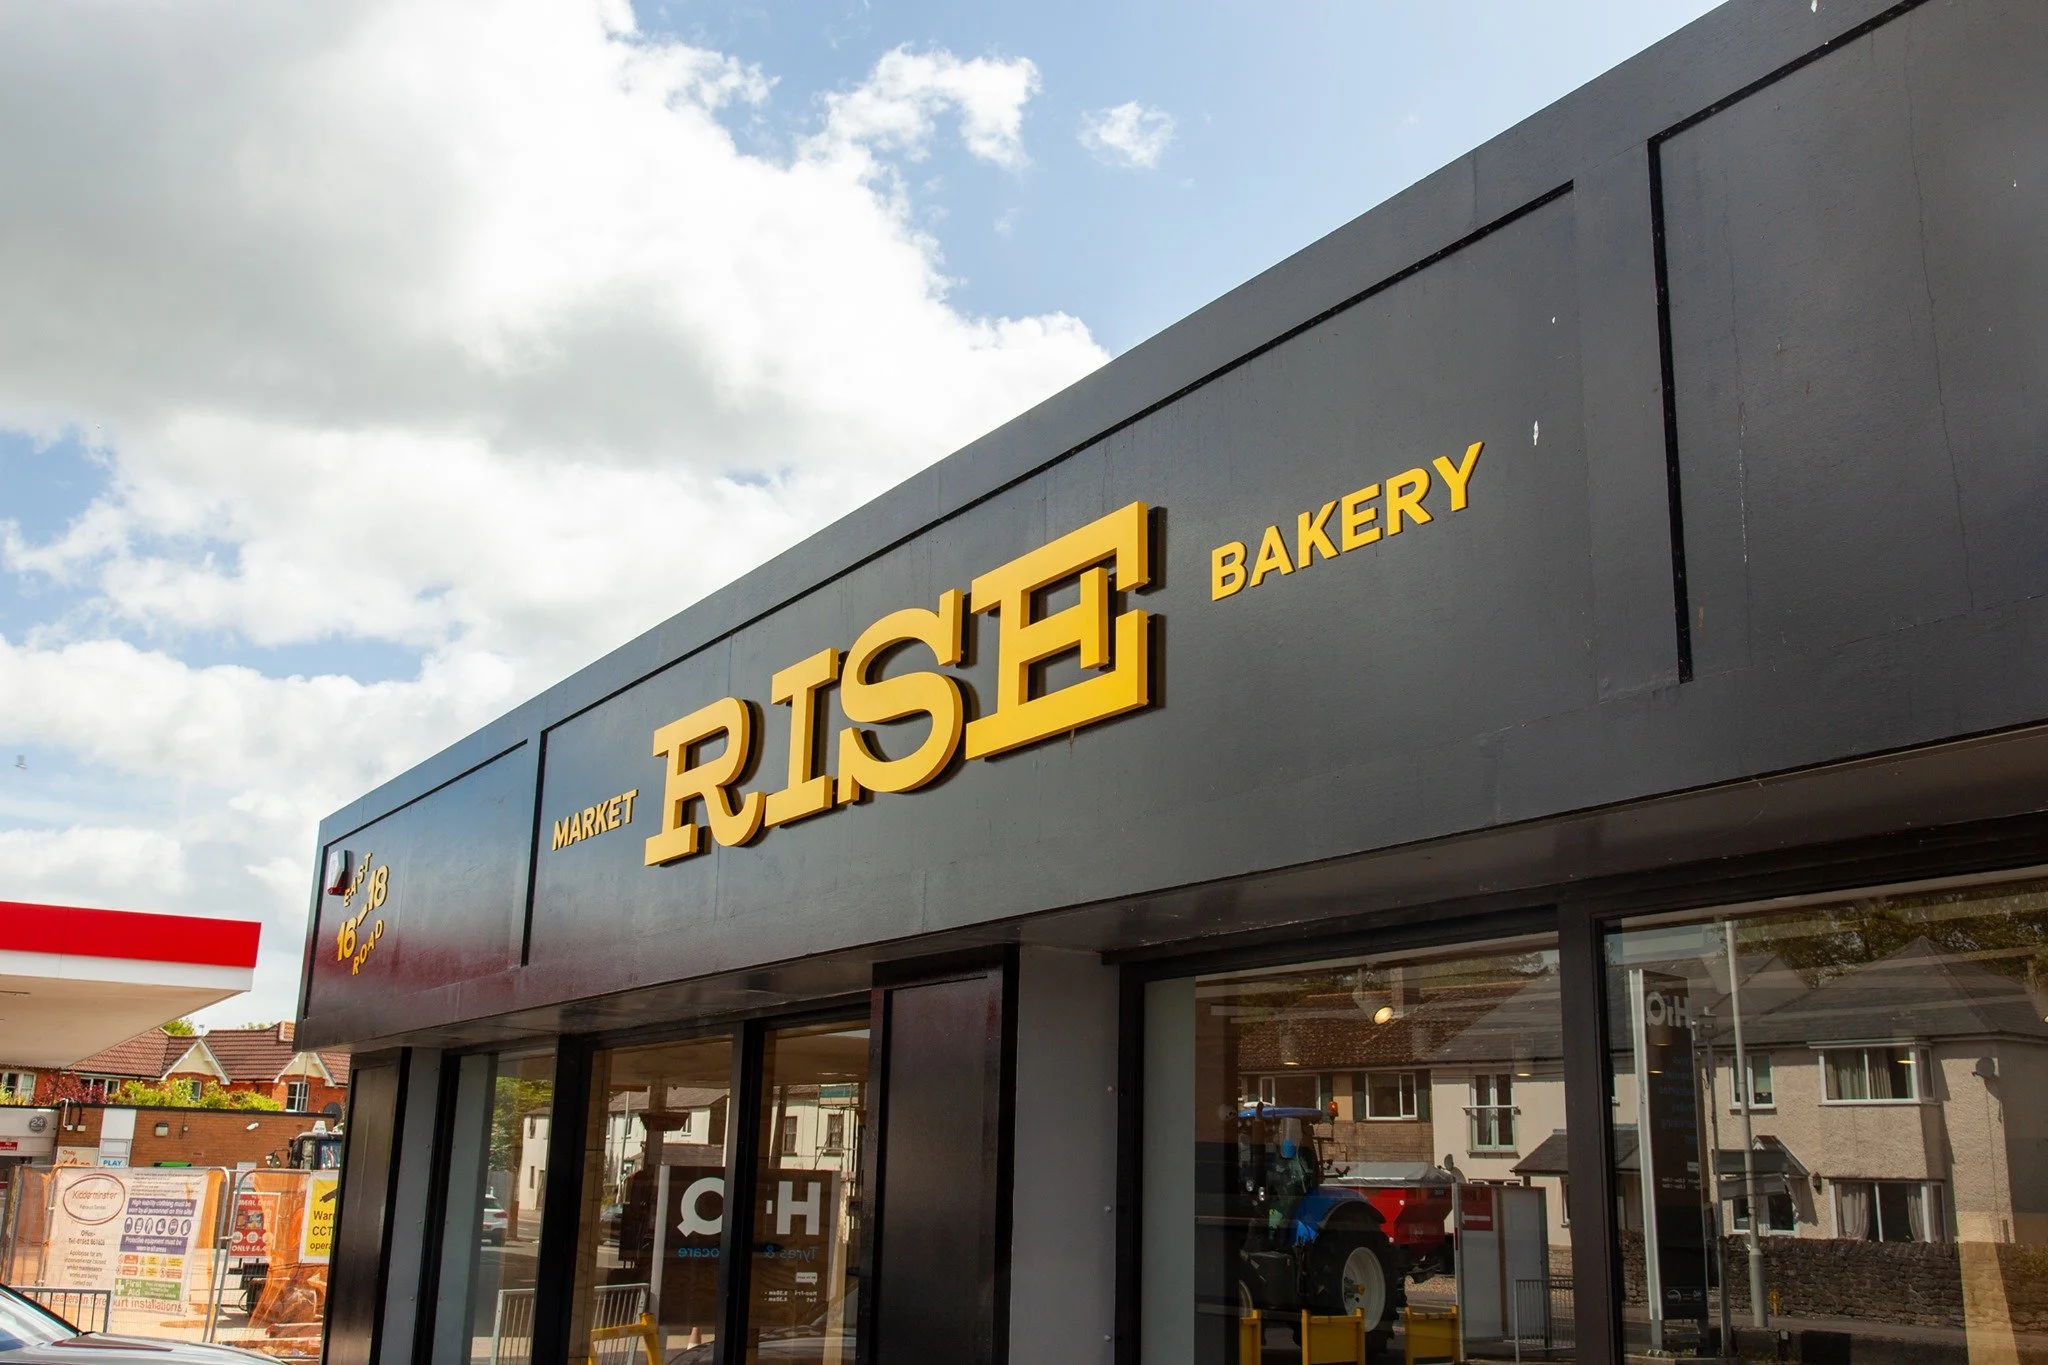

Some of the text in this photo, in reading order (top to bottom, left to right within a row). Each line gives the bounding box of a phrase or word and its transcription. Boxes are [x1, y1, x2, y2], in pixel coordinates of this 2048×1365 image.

[552, 441, 1484, 867] MARKET RISE BAKERY
[344, 852, 373, 907] EAST
[352, 919, 384, 975] ROAD
[313, 1210, 334, 1221] War
[131, 1298, 183, 1313] installations
